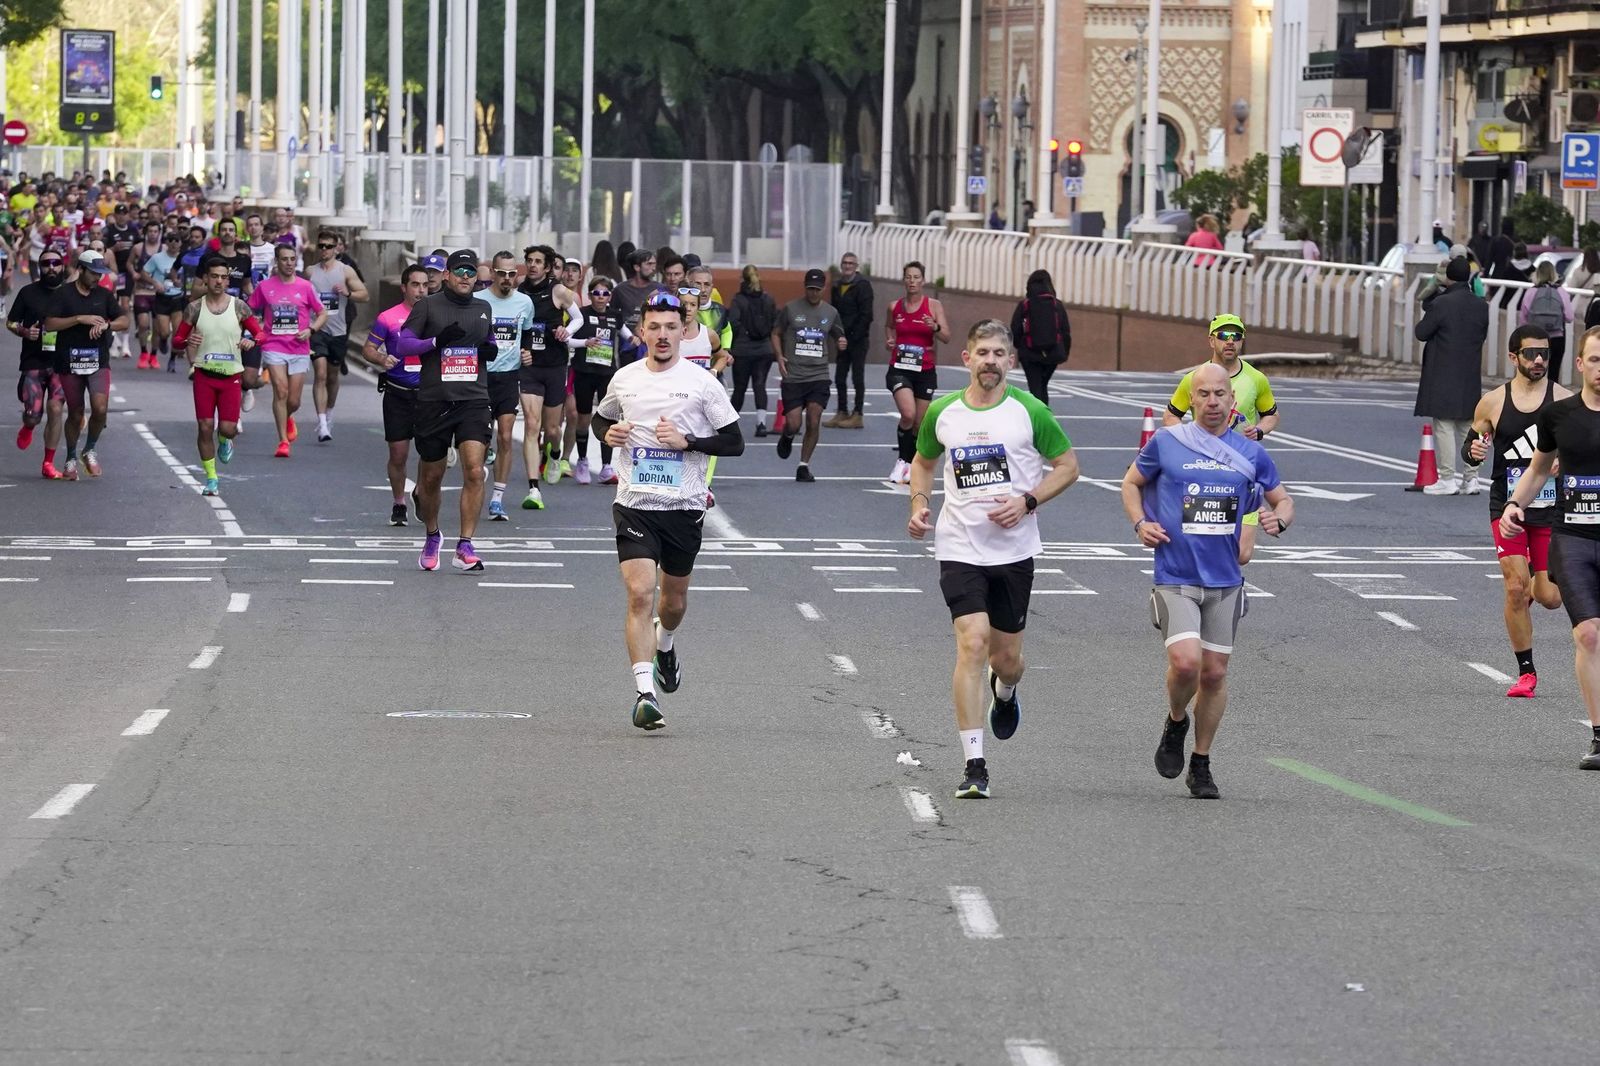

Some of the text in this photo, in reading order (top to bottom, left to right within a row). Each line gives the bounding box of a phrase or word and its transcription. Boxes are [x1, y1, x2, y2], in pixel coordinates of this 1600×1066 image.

[1568, 138, 1591, 167] P
[444, 365, 476, 374] AUGUSTO
[649, 450, 677, 459] ZURICH
[968, 447, 999, 457] ZURICH
[648, 464, 664, 472] 5763
[971, 462, 988, 472] 3977
[638, 472, 674, 485] DORIAN
[960, 470, 1005, 487] THOMAS
[1203, 485, 1235, 493] ZURICH
[1203, 500, 1221, 509] 4791
[1194, 511, 1228, 523] ANGEL
